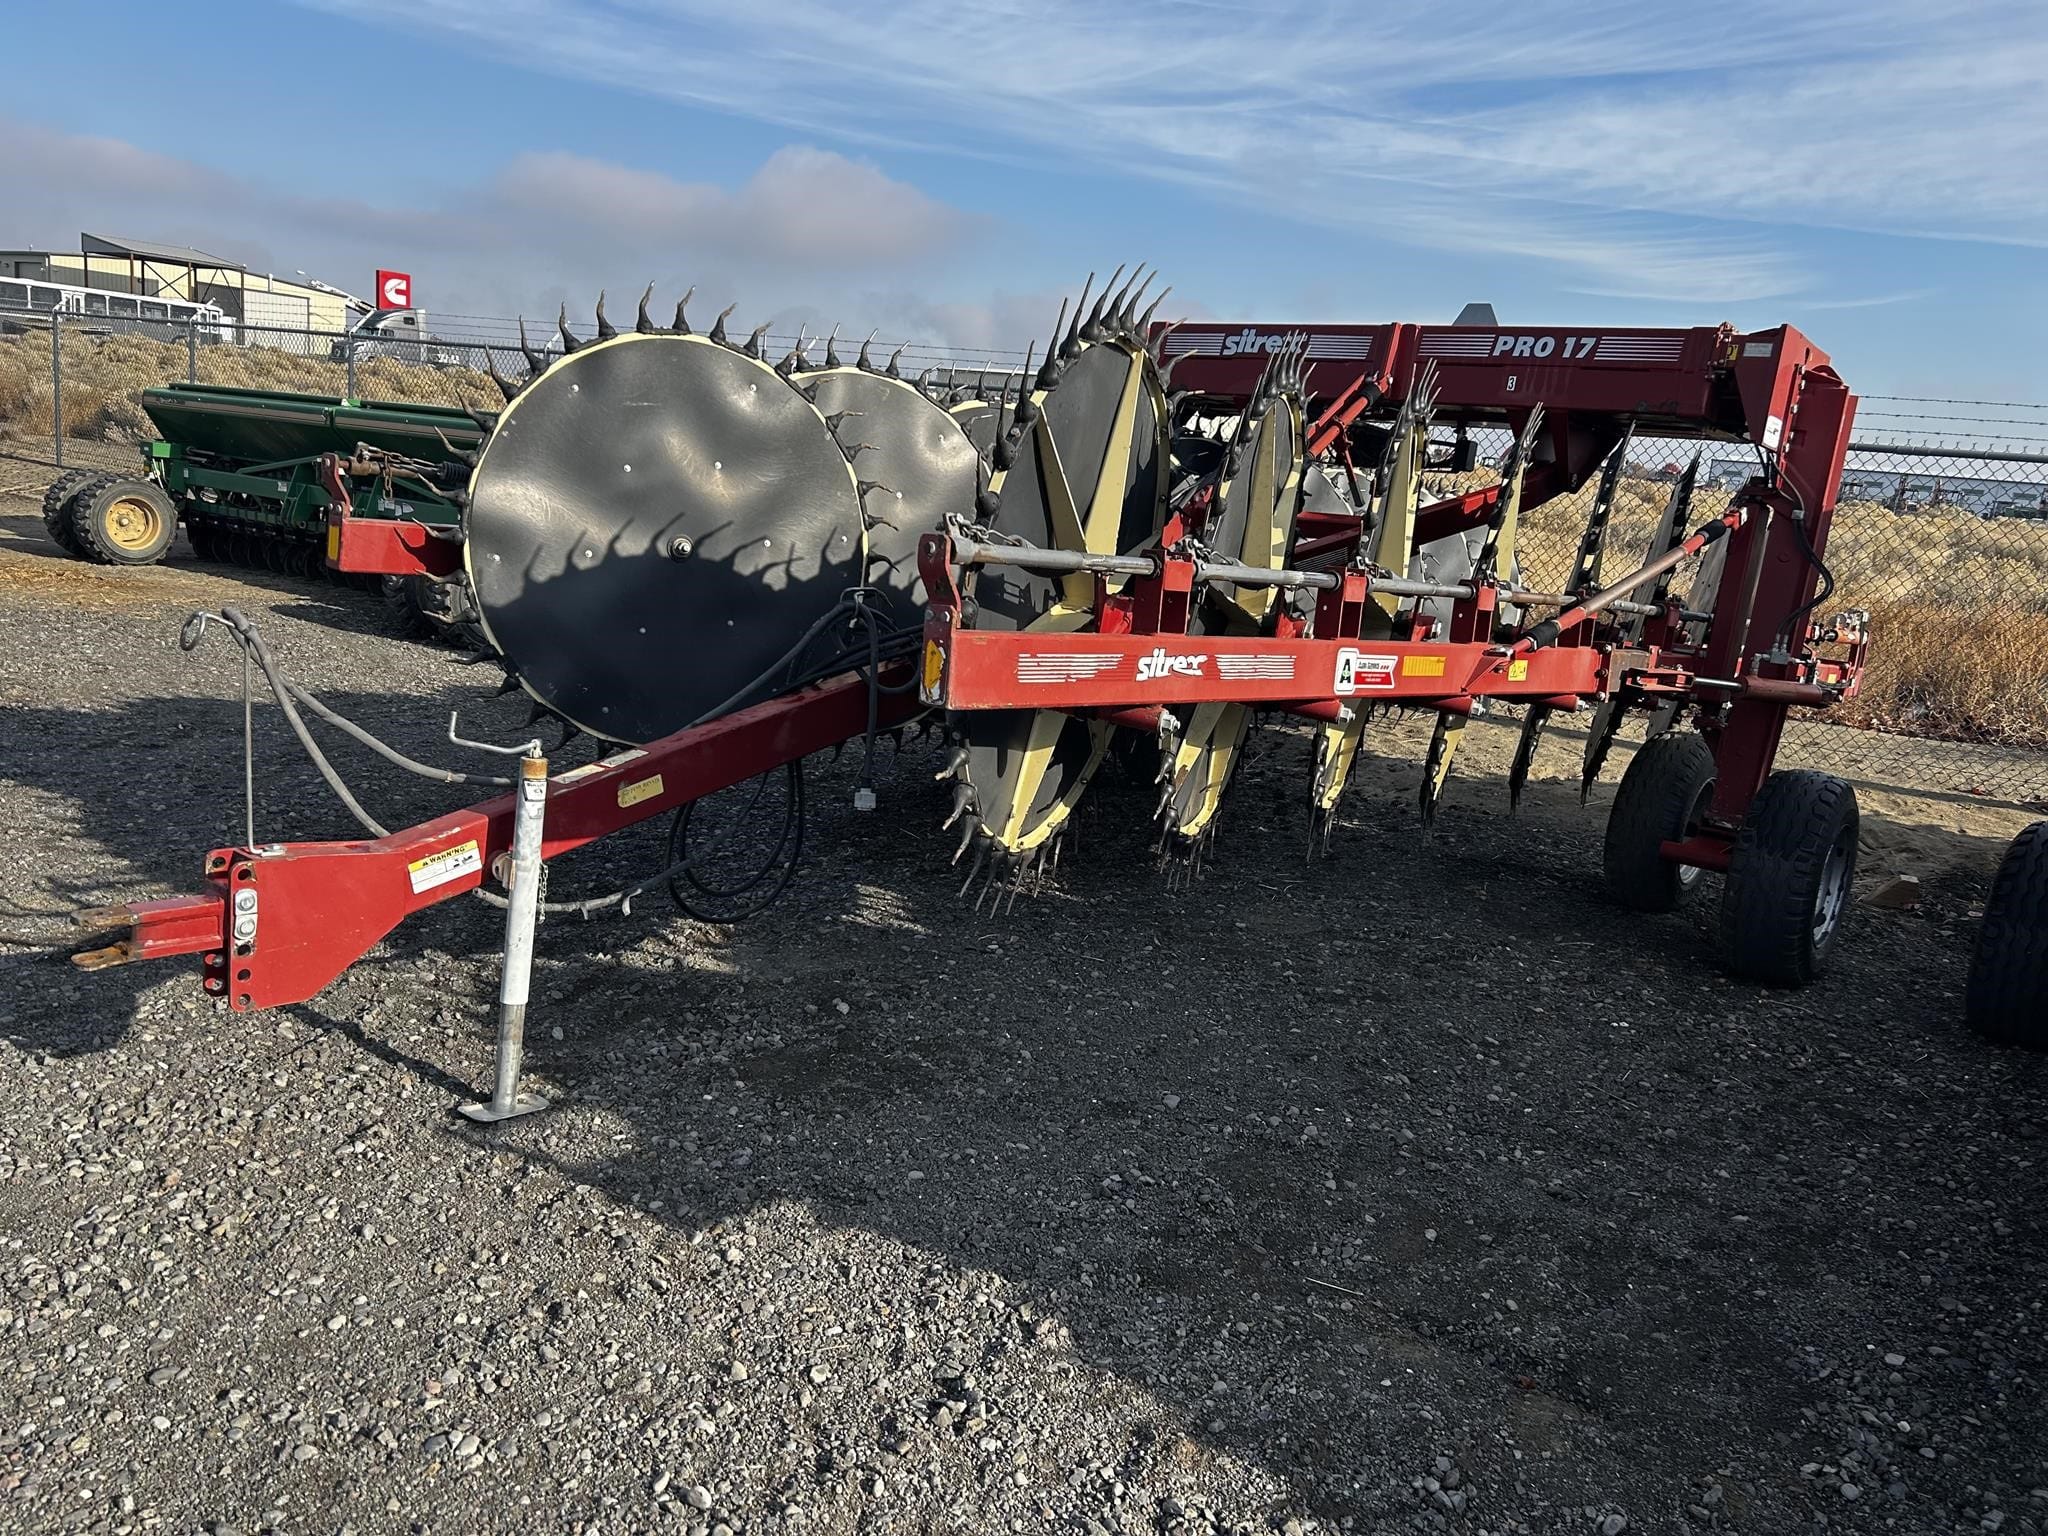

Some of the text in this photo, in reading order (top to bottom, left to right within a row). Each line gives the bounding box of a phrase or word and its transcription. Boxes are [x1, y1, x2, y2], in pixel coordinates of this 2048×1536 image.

[1492, 335, 1597, 359] PRO 17
[1507, 376, 1516, 391] 3
[1135, 647, 1208, 682] sitrex
[429, 846, 466, 863] WARNING
